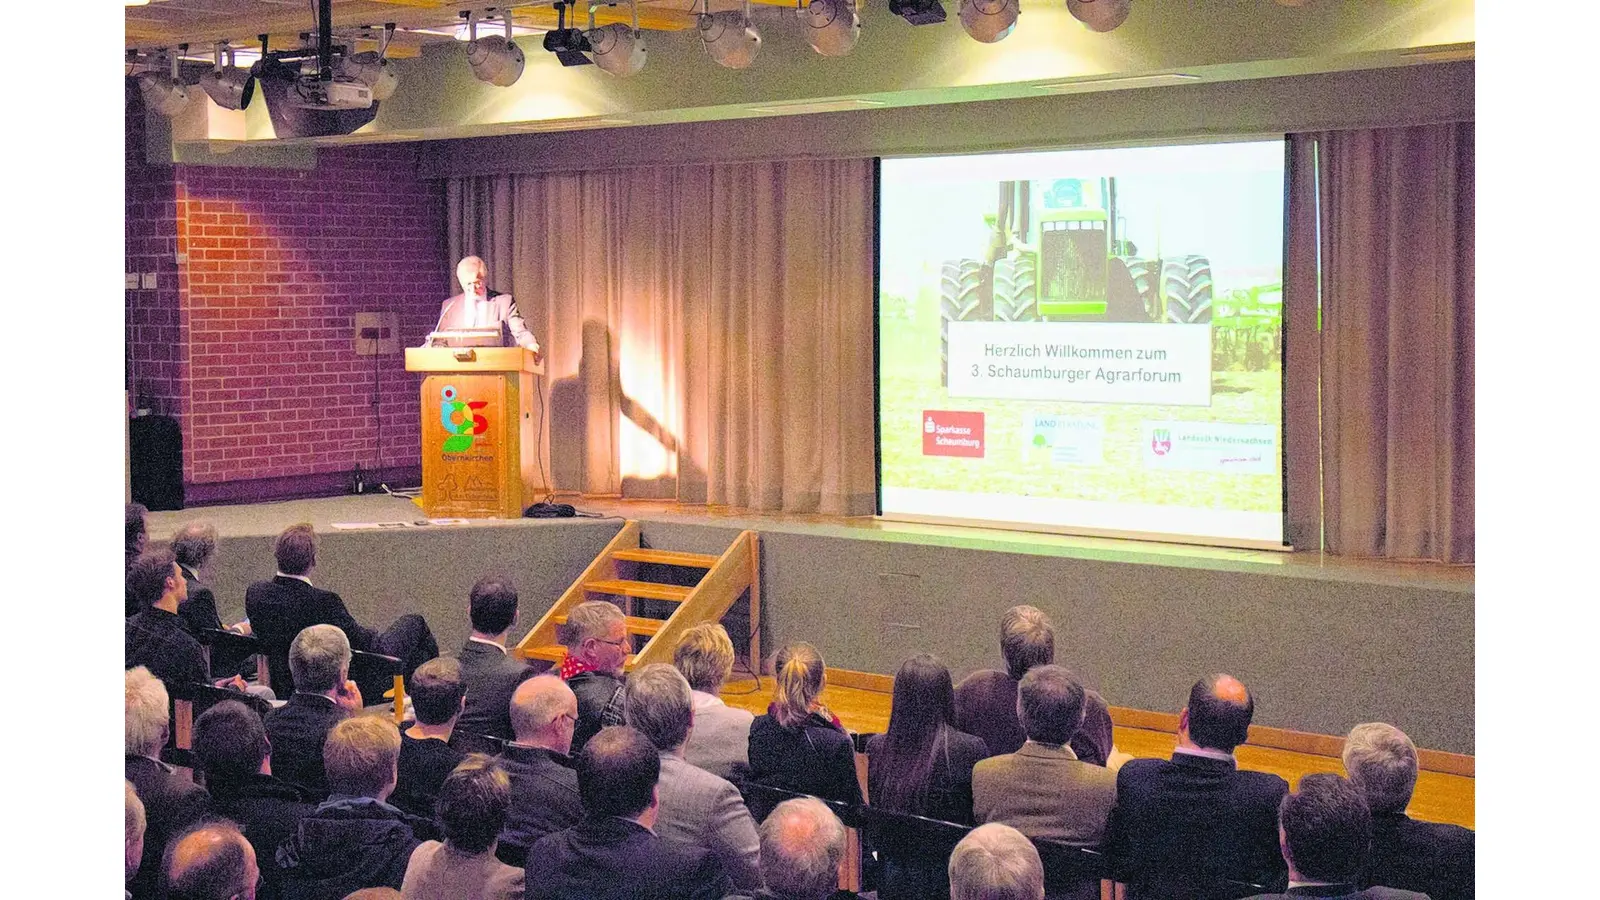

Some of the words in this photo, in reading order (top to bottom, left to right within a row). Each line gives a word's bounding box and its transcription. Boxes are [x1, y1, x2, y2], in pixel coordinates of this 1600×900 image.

[984, 343, 1041, 357] Herzlich
[1045, 344, 1133, 359] Willkommen
[1136, 348, 1167, 360] zum
[971, 363, 983, 377] 3.
[987, 364, 1091, 383] Schaumburger
[1095, 367, 1181, 384] Agrarforum
[936, 424, 972, 435] Sparkasse
[936, 436, 980, 449] Schaumburg
